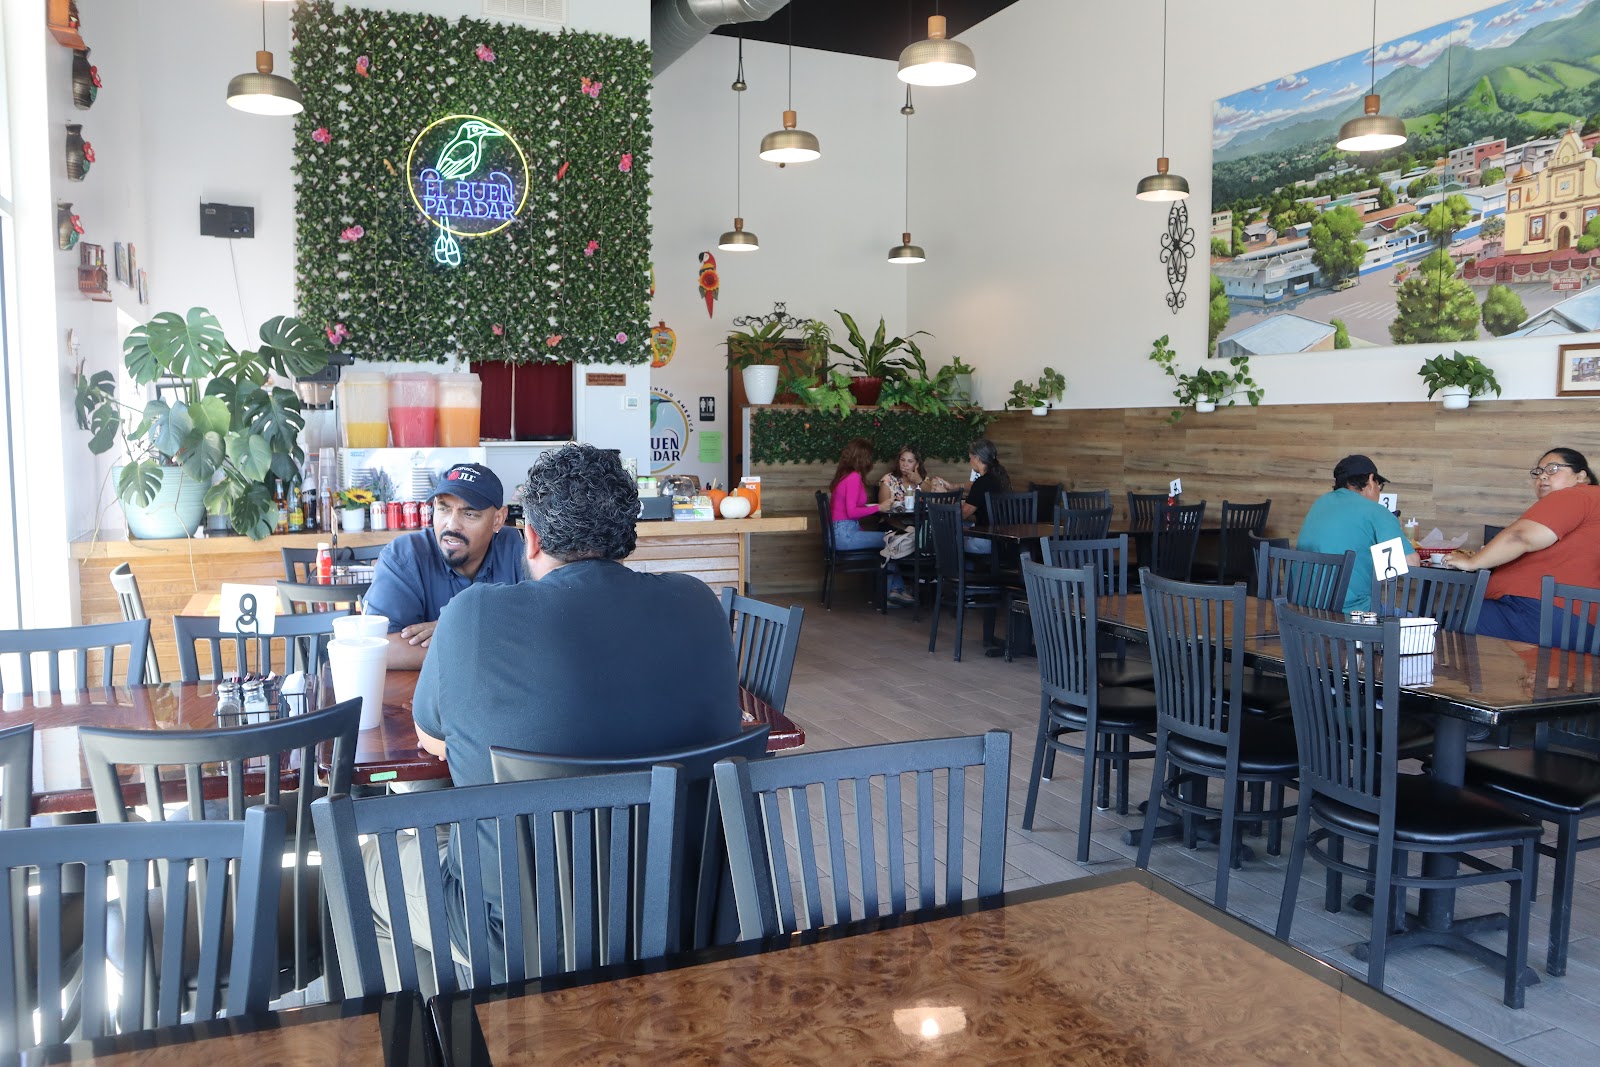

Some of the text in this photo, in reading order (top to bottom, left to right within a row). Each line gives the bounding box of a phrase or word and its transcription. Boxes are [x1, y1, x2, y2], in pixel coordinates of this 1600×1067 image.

[422, 174, 514, 204] EL BUEN
[423, 197, 516, 220] PALADAR
[650, 386, 674, 398] ENTRO
[650, 434, 679, 450] UEN
[650, 450, 681, 462] DAR
[1382, 496, 1390, 510] 3
[1381, 546, 1393, 572] 7
[238, 592, 257, 626] 9
